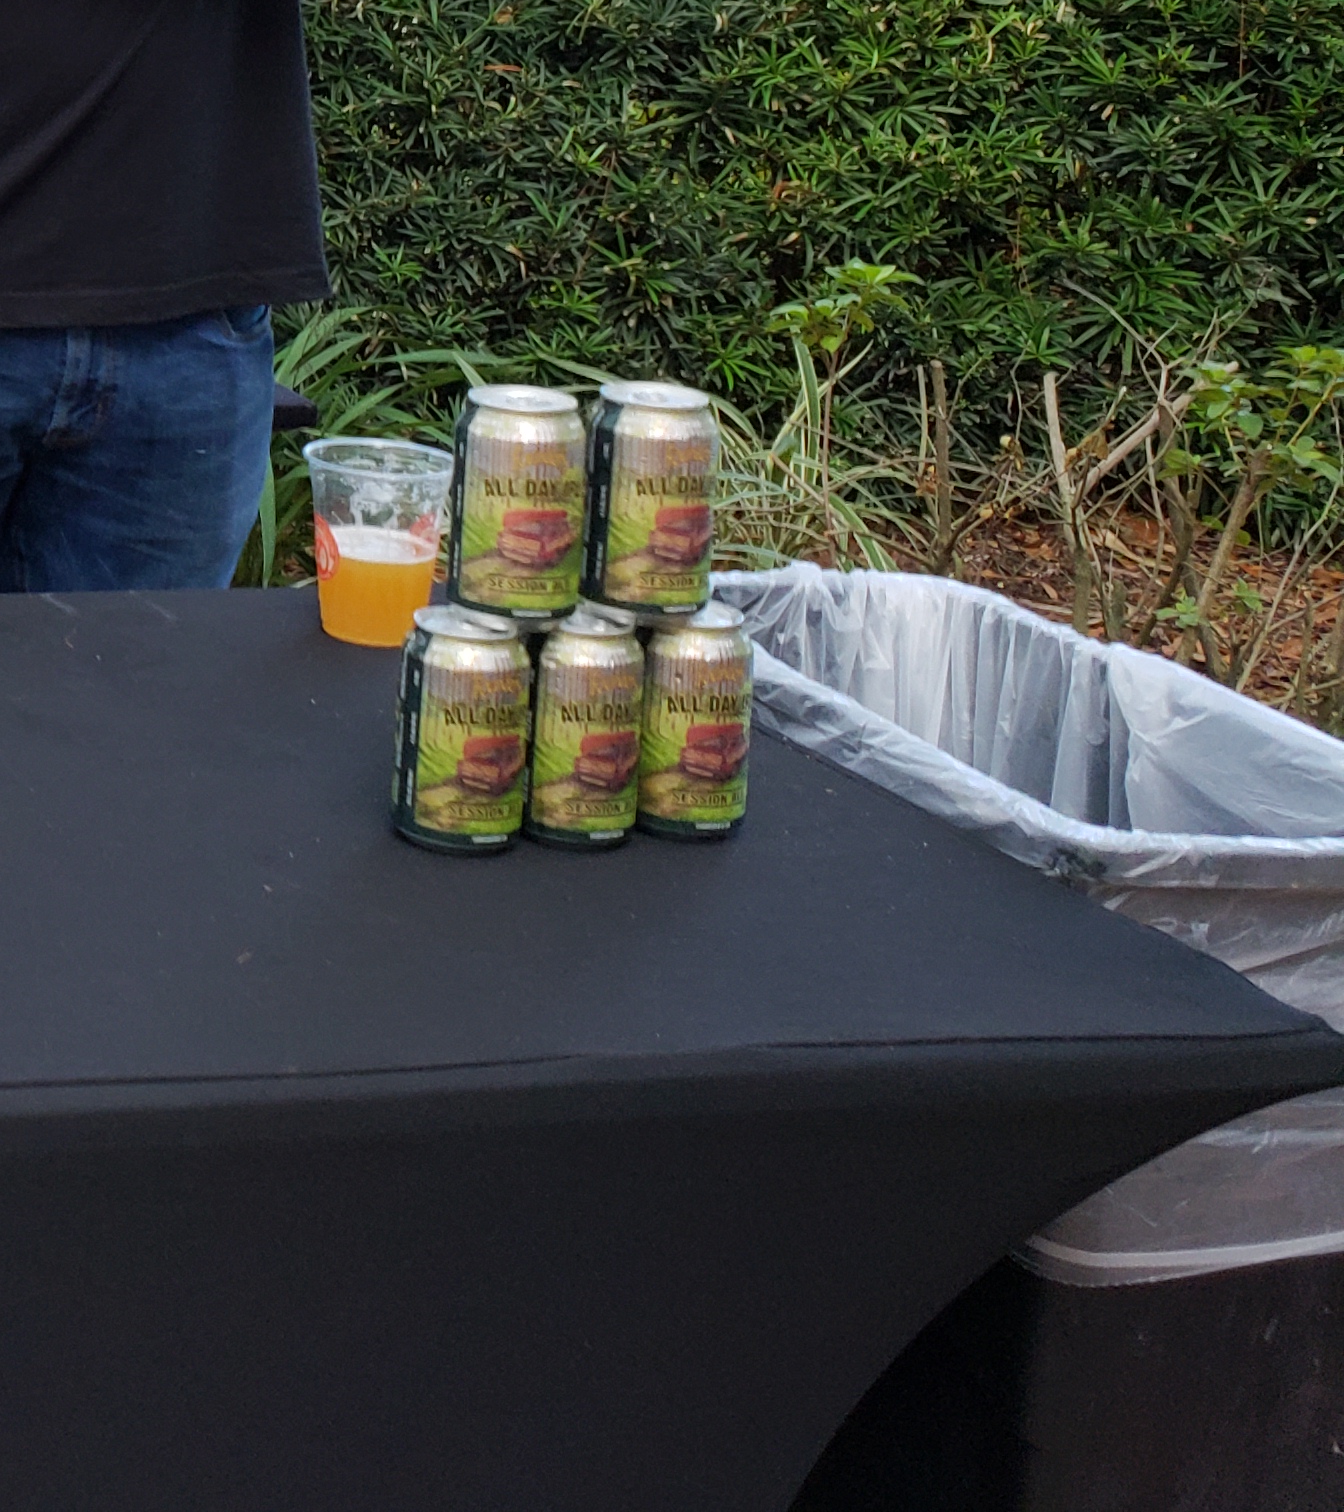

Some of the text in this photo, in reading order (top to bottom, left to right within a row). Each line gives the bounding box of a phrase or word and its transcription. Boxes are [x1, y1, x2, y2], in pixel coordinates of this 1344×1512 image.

[484, 477, 518, 497] ALL
[636, 478, 672, 497] ALL
[561, 703, 596, 723] ALL
[667, 695, 703, 714] ALL
[443, 707, 478, 727] ALL
